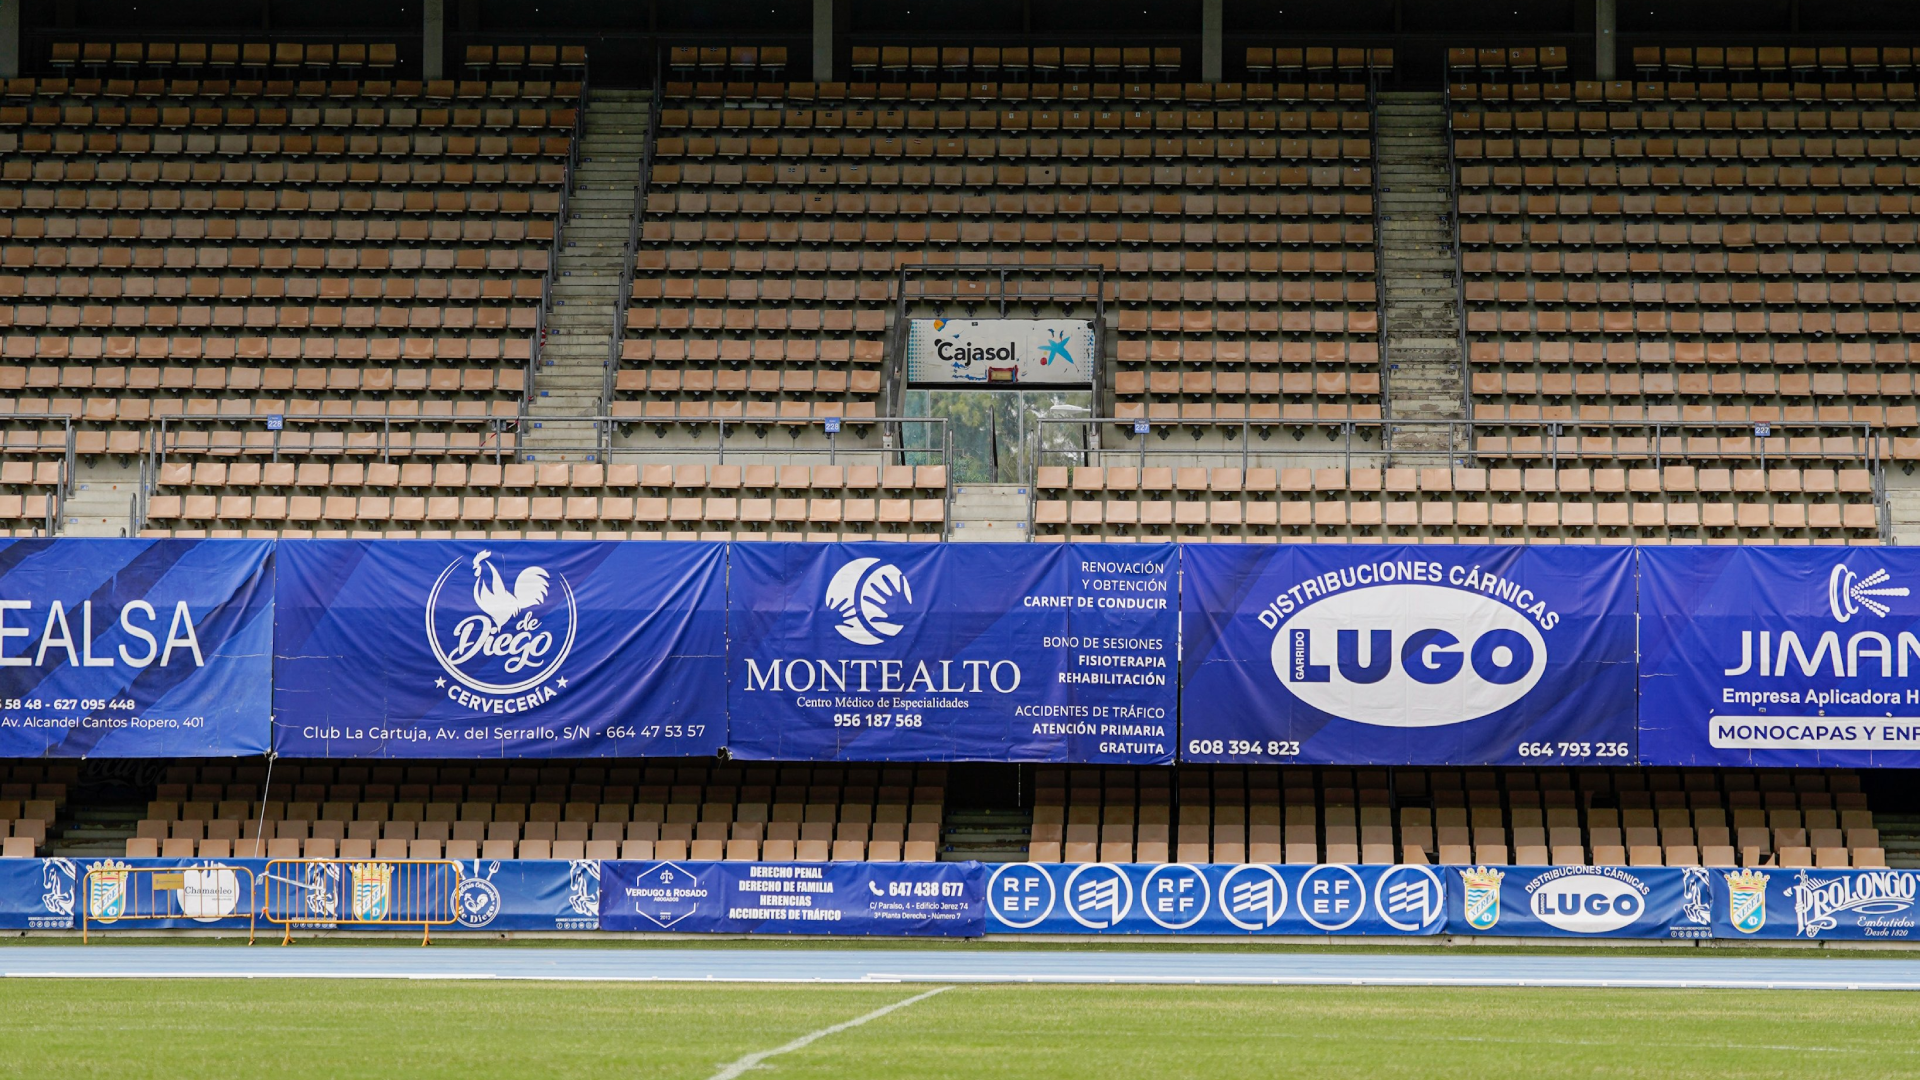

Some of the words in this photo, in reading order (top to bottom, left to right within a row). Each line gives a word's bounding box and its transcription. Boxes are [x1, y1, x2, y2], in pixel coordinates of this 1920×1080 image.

[937, 341, 1016, 367] Cajasol
[1082, 561, 1164, 574] RENOVACIÓN
[1082, 579, 1090, 589] Y
[1093, 578, 1167, 591] OBTENCIÓN
[1024, 596, 1073, 607] CARNET
[1078, 597, 1093, 607] DE
[1098, 597, 1167, 609] CONDUCIR
[1258, 561, 1443, 629] DISTRIBUCIONES
[1449, 565, 1560, 630] CÁRNICAS
[516, 611, 542, 631] de
[0, 600, 204, 668] EALSA
[449, 615, 552, 673] Diego
[1043, 637, 1079, 648] BONO
[1083, 637, 1099, 648] DE
[1103, 638, 1163, 650] SESIONES
[1079, 655, 1166, 667] FISIOTERAPIA
[1289, 628, 1534, 685] LUGO
[1295, 631, 1305, 680] GARRIDO
[744, 658, 1021, 693] MONTEALTO
[1058, 672, 1165, 685] REHABILITACIÓN
[5, 699, 21, 709] 58
[24, 699, 42, 709] 48
[54, 699, 78, 710] 627
[81, 699, 106, 710] 095
[109, 699, 135, 710] 448
[447, 684, 557, 714] CERVECERÍA
[797, 696, 832, 707] Centro
[835, 697, 874, 708] Médico
[877, 697, 890, 708] de
[893, 697, 969, 710] Especialidades
[1723, 688, 1800, 706] Empresa
[1804, 689, 1900, 707] Aplicadora
[1907, 689, 1919, 704] H
[1015, 705, 1088, 717] ACCIDENTES
[1093, 706, 1109, 717] DE
[1112, 704, 1165, 718] TRÁFICO
[2, 717, 20, 728] Av.
[23, 716, 79, 728] Alcandel
[82, 717, 128, 728] Cantos
[131, 717, 180, 730] Ropero,
[183, 717, 204, 728] 401
[834, 714, 861, 727] 956
[865, 714, 892, 727] 187
[895, 714, 922, 727] 568
[303, 726, 340, 739] Club
[346, 727, 363, 739] La
[369, 727, 431, 742] Cartuja,
[436, 728, 459, 739] Av.
[464, 727, 488, 739] del
[494, 726, 558, 742] Serrallo,
[563, 725, 590, 740] S/N
[607, 726, 636, 738] 664
[641, 726, 660, 737] 47
[665, 725, 682, 737] 53
[687, 725, 705, 737] 57
[1032, 721, 1096, 735] ATENCIÓN
[1101, 724, 1165, 736] PRIMARIA
[1719, 725, 1857, 740] MONOCAPAS
[1863, 726, 1876, 740] Y
[1099, 742, 1164, 754] GRATUITA
[1189, 740, 1223, 754] 608
[1228, 740, 1263, 755] 394
[1268, 741, 1300, 755] 823
[1518, 742, 1554, 756] 664
[1558, 742, 1591, 757] 793
[1596, 742, 1628, 757] 236
[750, 866, 793, 878] DERECHO
[794, 867, 822, 878] PENAL
[739, 880, 781, 892] DERECHO
[783, 881, 795, 892] DE
[797, 881, 833, 893] FAMILIA
[1004, 877, 1039, 892] RF
[1159, 878, 1194, 893] RF
[1314, 880, 1350, 894] RF
[1525, 865, 1602, 894] DISTRIBUCIONES
[1604, 867, 1650, 895] CÁRNICAS
[625, 888, 665, 898] VERDUGO
[666, 888, 672, 897] &
[673, 888, 708, 898] ROSADO
[889, 882, 912, 896] 647
[914, 882, 939, 896] 438
[942, 882, 963, 896] 677
[760, 895, 811, 906] HERENCIAS
[878, 902, 904, 910] Paraíso,
[941, 902, 958, 910] Jerez
[1004, 897, 1039, 911] EF
[1158, 898, 1194, 912] EF
[1314, 899, 1350, 913] EF
[1538, 893, 1640, 916] LUGO
[1794, 871, 1916, 935] PROLONGO
[729, 908, 787, 919] ACCIDENTES
[788, 909, 800, 920] DE
[802, 908, 841, 920] TRÁFICO
[1856, 916, 1915, 927] Embutidos
[1864, 927, 1889, 936] Desde
